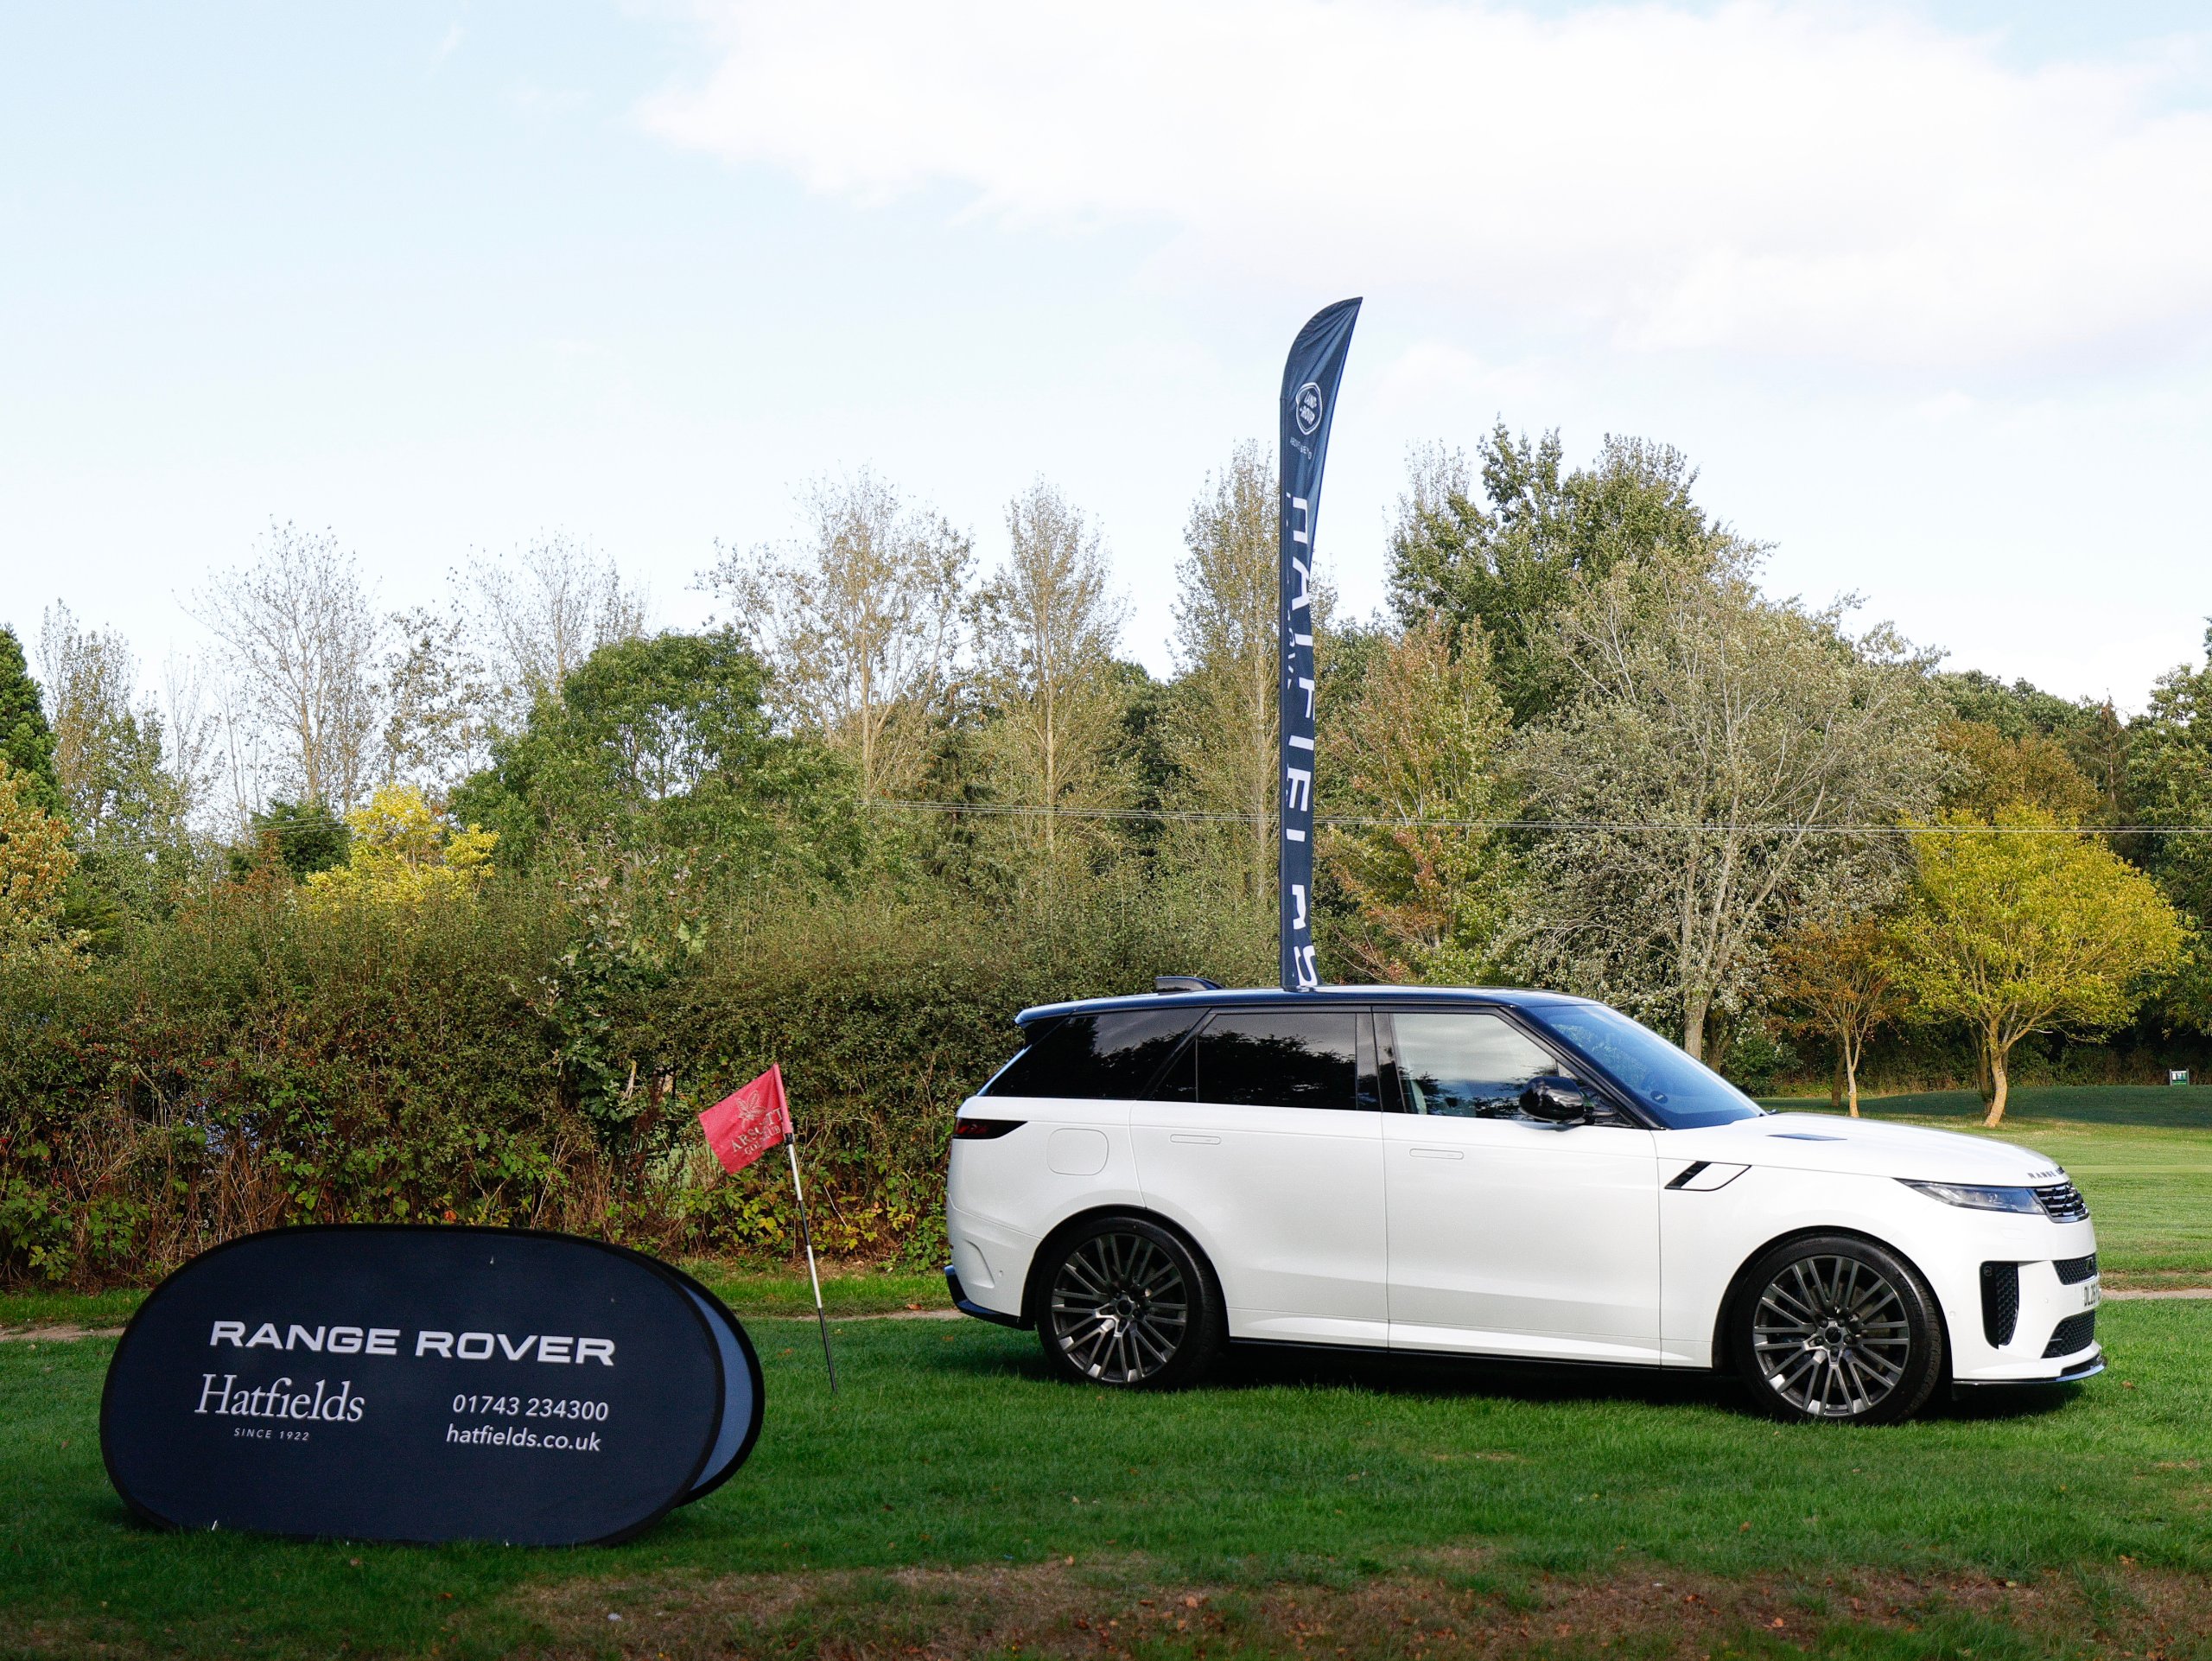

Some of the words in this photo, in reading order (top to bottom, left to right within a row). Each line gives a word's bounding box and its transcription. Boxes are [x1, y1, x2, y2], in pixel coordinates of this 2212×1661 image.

[209, 1321, 401, 1356] RANGE
[415, 1330, 615, 1366] ROVER
[194, 1373, 365, 1422] Hatfields
[452, 1394, 519, 1416] 01743
[524, 1397, 609, 1422] 234300
[233, 1428, 272, 1438] SINCE
[279, 1430, 310, 1441] 1922
[446, 1422, 601, 1452] hatfields.co.uk
